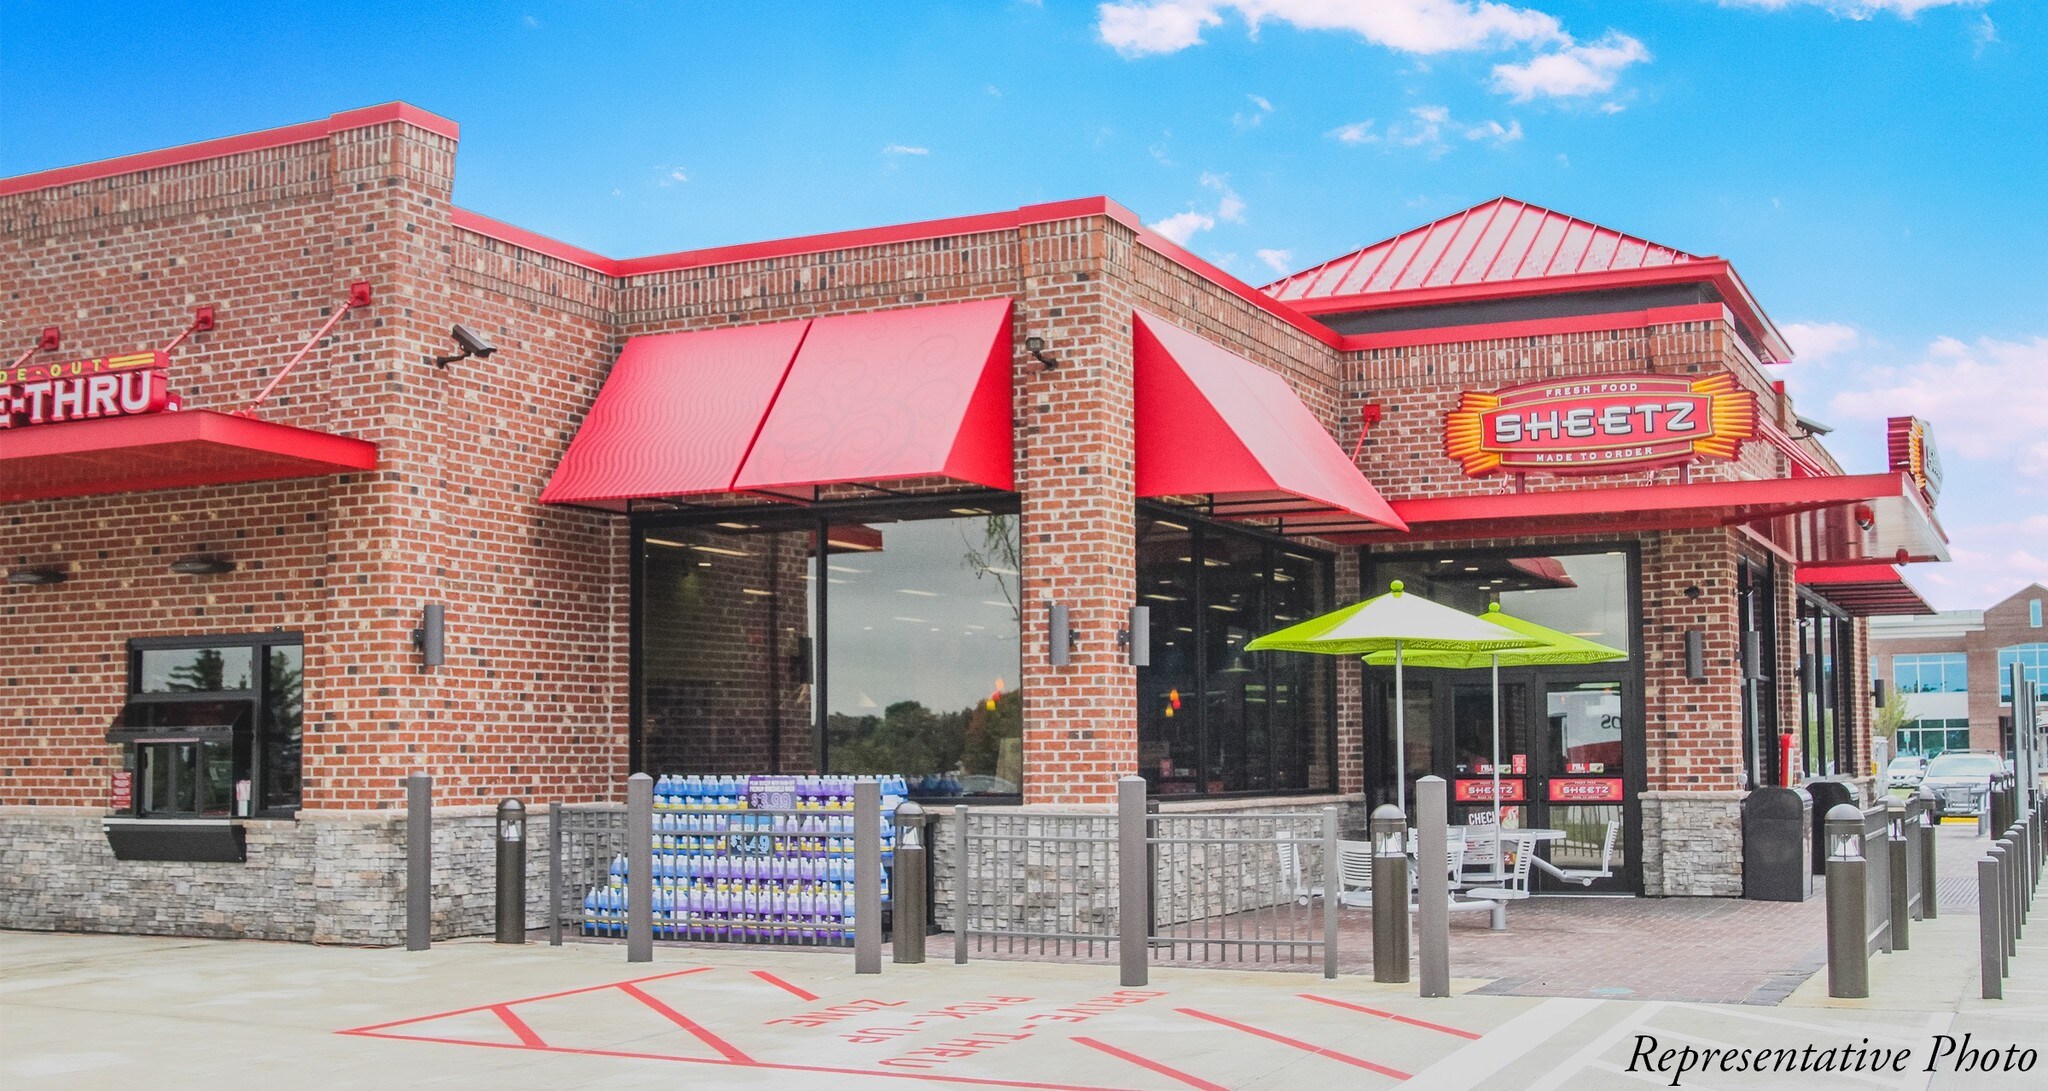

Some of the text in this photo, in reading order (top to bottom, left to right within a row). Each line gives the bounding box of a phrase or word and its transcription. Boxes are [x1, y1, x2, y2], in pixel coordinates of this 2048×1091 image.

[1546, 383, 1637, 397] FRESH FOOD
[1495, 402, 1695, 443] SHEETZ
[1536, 447, 1652, 462] MADE TO ORDER
[1468, 786, 1513, 794] SHETZ
[1563, 786, 1609, 794] SHEETZ
[764, 999, 907, 1028] ZONE
[839, 995, 1035, 1044] PICK-UP
[879, 990, 1168, 1068] DRIVE-THRU
